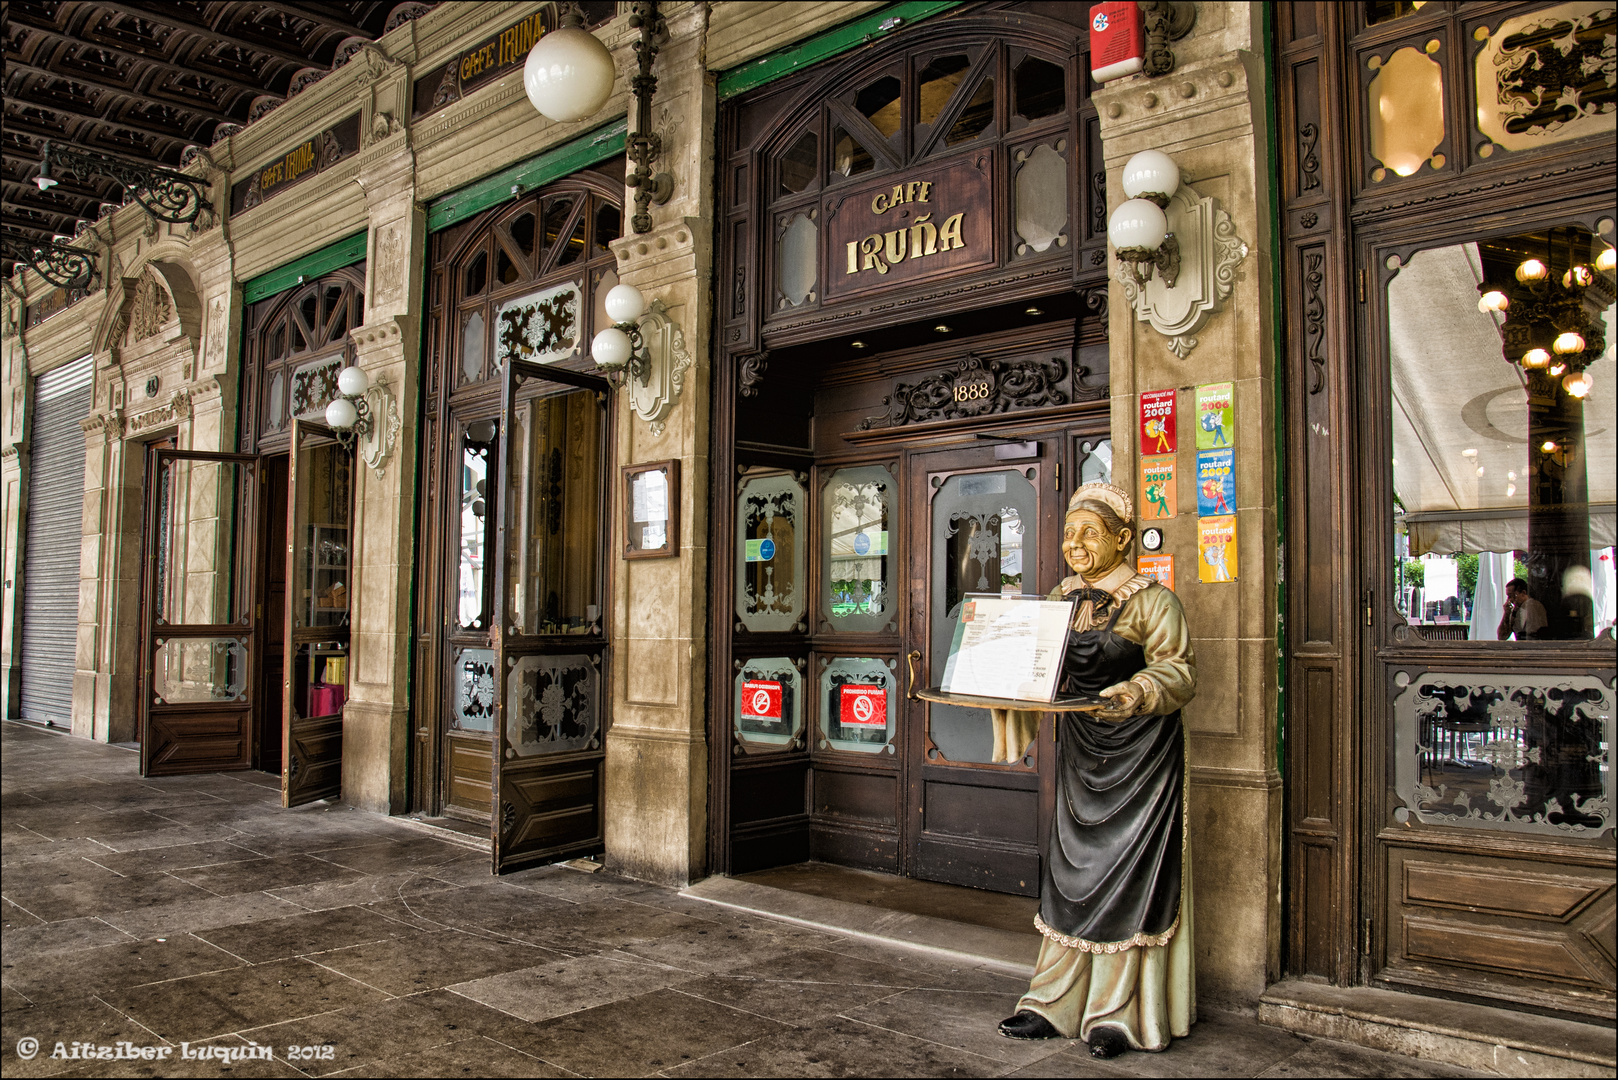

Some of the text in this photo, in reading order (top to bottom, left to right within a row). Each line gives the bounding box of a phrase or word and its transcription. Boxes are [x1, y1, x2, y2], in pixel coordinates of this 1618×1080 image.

[871, 181, 932, 214] CAFE
[846, 212, 965, 274] IRUÑA
[952, 382, 989, 402] 1888
[1200, 392, 1230, 402] routard
[1144, 399, 1172, 409] routard
[1201, 400, 1229, 411] 2006
[1144, 407, 1172, 418] 2008
[1200, 459, 1231, 469] routard
[1144, 465, 1172, 474] routard
[1201, 466, 1231, 478] 2009
[1146, 473, 1172, 482] 2005
[1202, 526, 1233, 535] routard
[1203, 534, 1232, 544] 2010
[1140, 564, 1170, 573] routard
